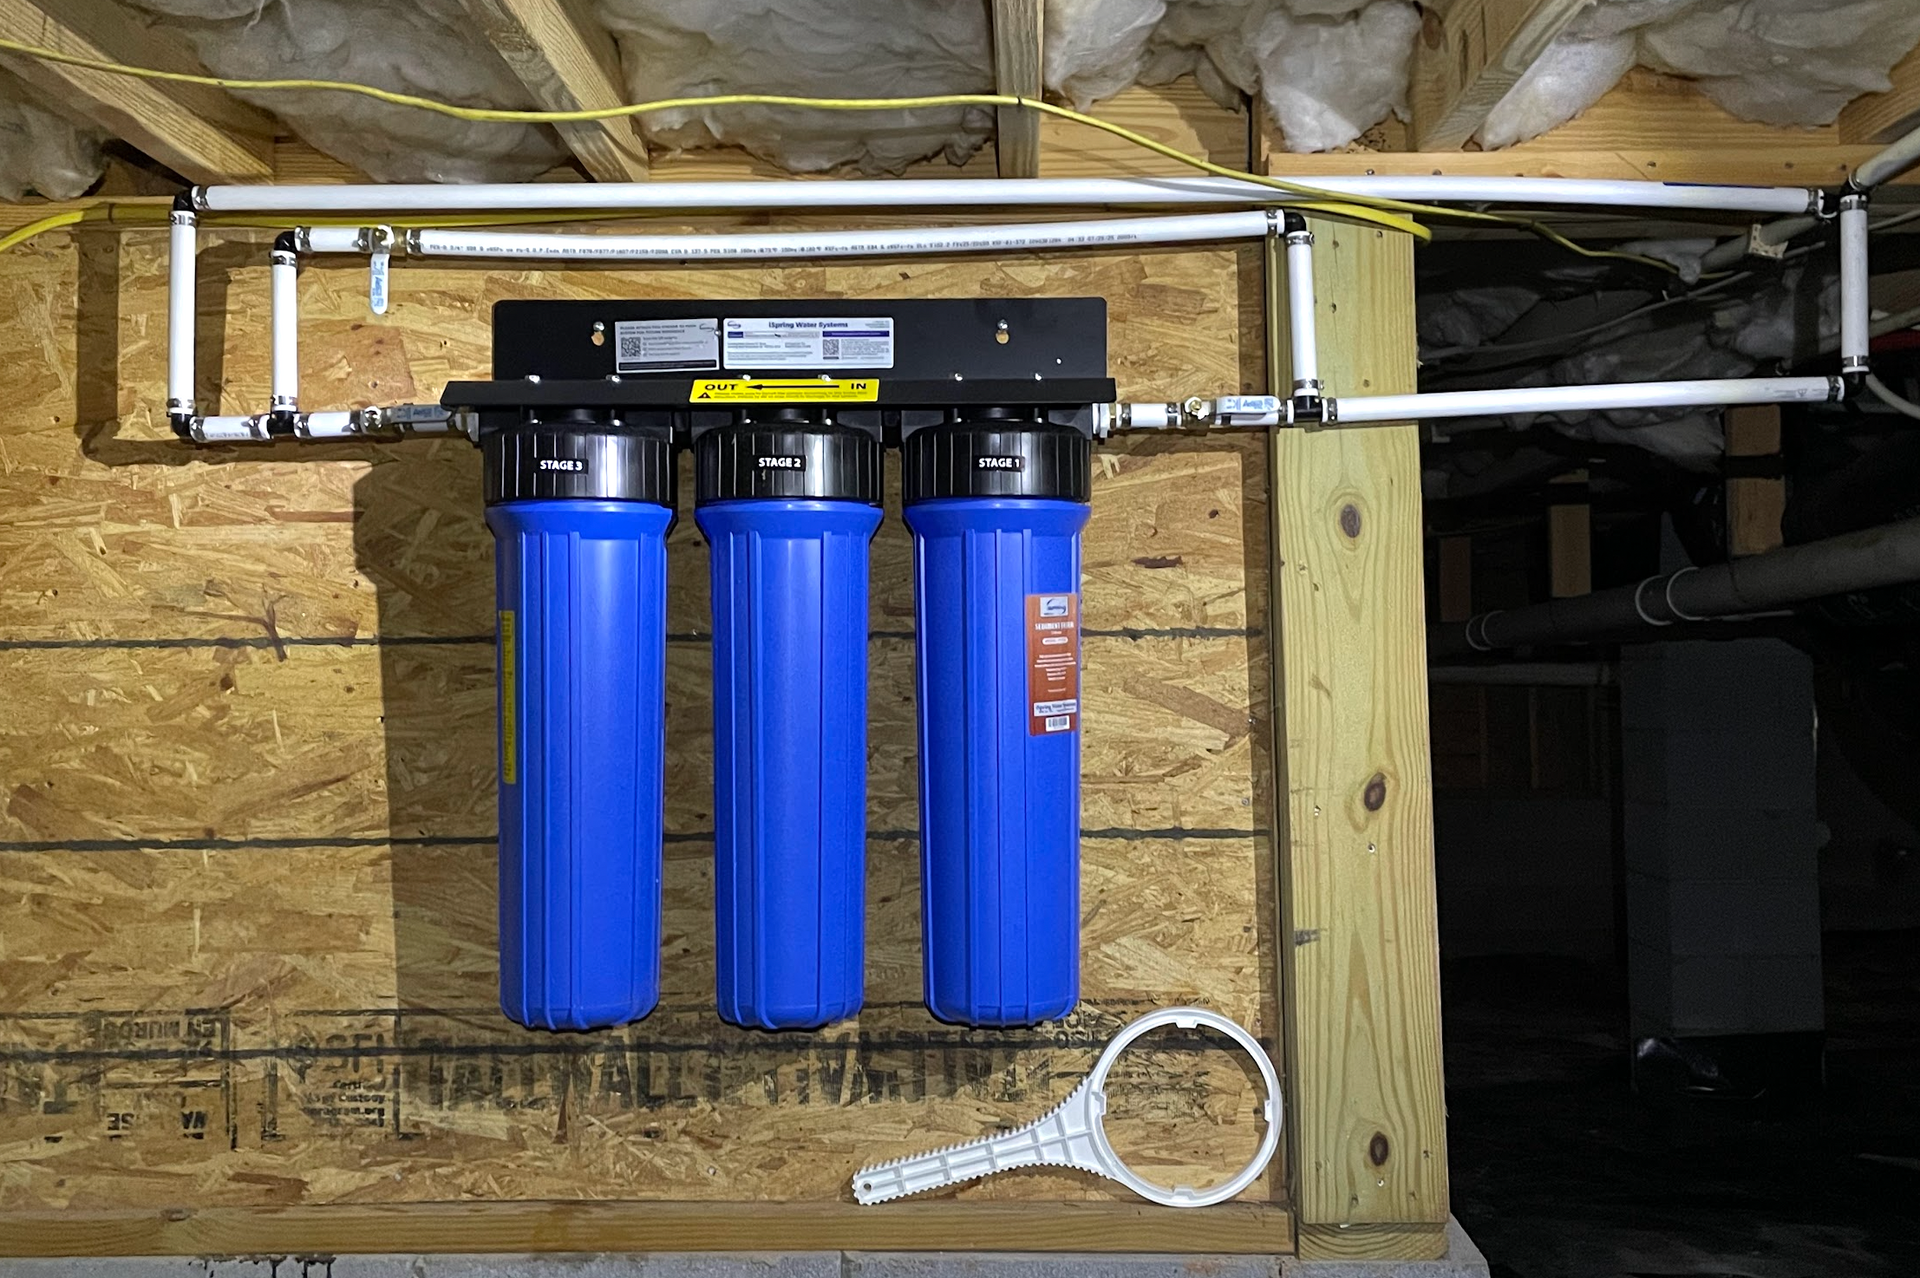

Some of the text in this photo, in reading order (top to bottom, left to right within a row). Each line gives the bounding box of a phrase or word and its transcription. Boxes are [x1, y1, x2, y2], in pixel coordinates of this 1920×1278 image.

[540, 460, 583, 471] STAGE 3
[758, 457, 801, 468] STAGE 2
[979, 458, 1020, 468] STAGE 1
